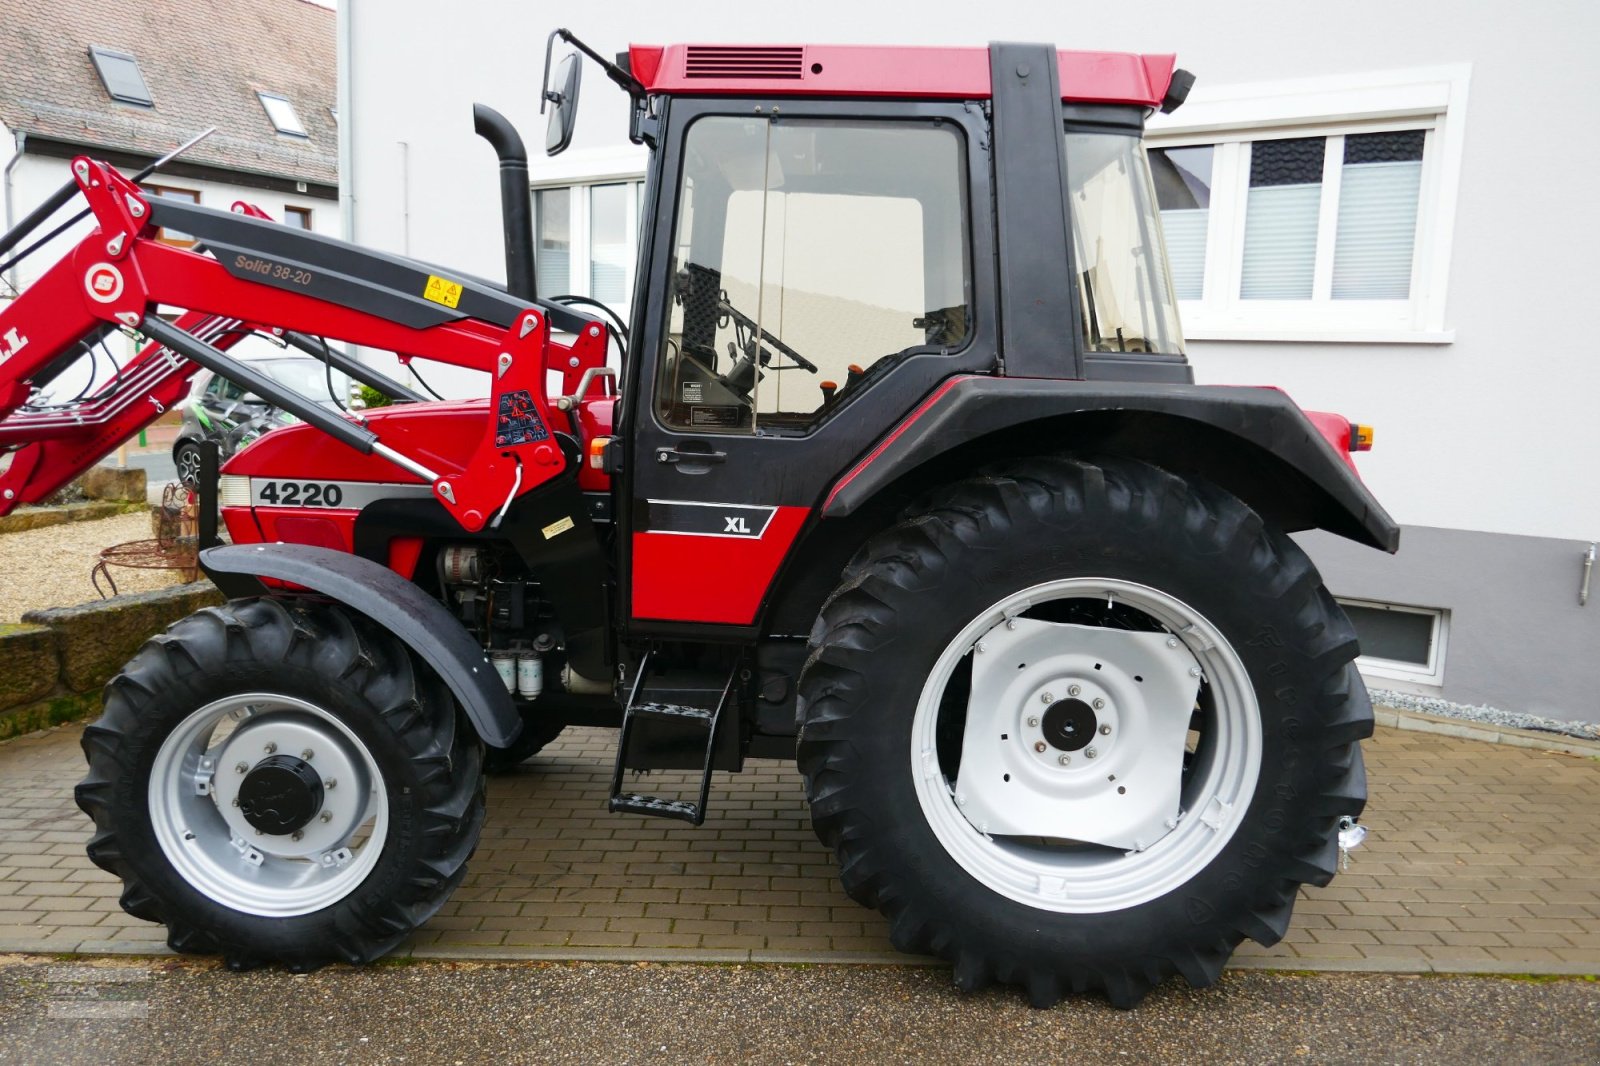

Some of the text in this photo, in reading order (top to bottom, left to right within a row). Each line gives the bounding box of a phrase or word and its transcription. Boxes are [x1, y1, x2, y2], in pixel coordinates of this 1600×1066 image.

[234, 255, 313, 286] Solid 38-20
[260, 481, 343, 507] 4220
[723, 516, 751, 534] XL
